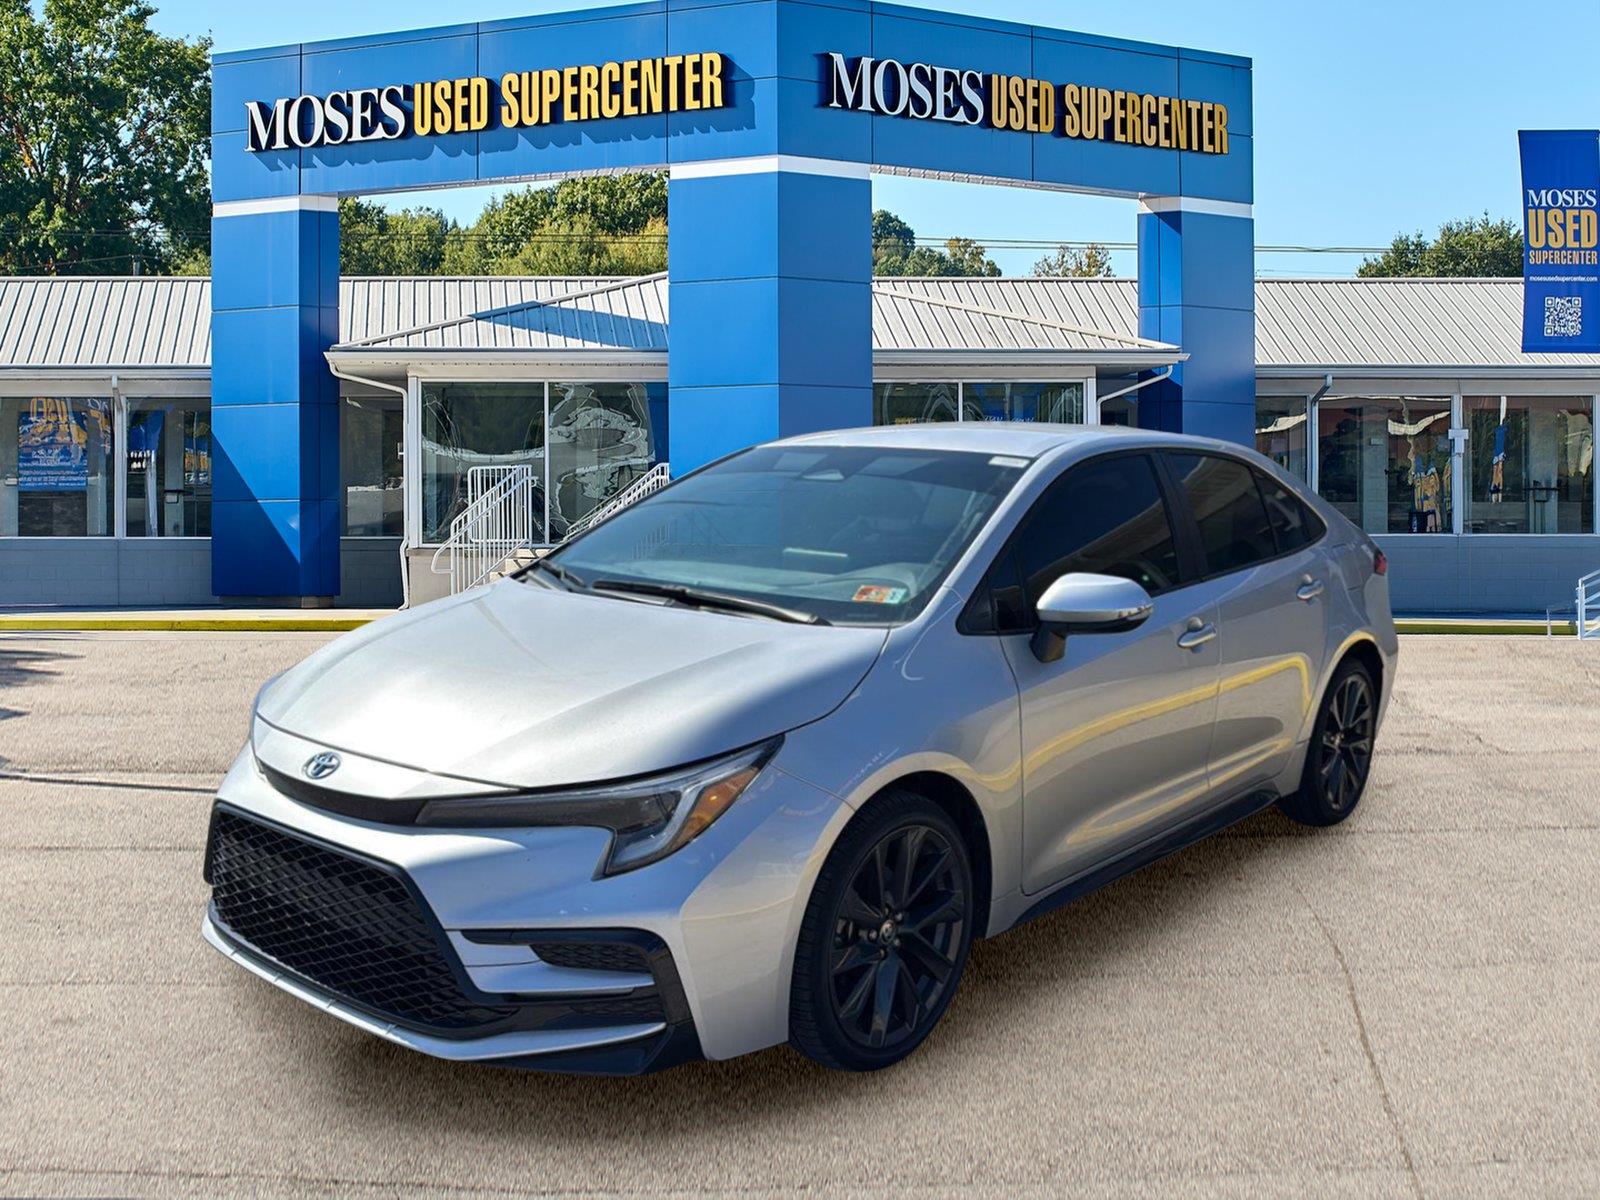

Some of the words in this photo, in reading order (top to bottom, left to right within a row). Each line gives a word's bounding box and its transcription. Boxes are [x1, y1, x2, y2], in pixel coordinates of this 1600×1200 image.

[244, 84, 405, 153] MOSES
[413, 76, 489, 137] USED
[500, 51, 725, 128] SUPERCENTER
[828, 52, 984, 125] MOSES
[991, 73, 1055, 134] USED
[1064, 83, 1229, 155] SUPERCENTER
[1527, 189, 1597, 208] MOSES
[1528, 208, 1598, 249] USED
[1529, 250, 1598, 265] SUPERCENTER
